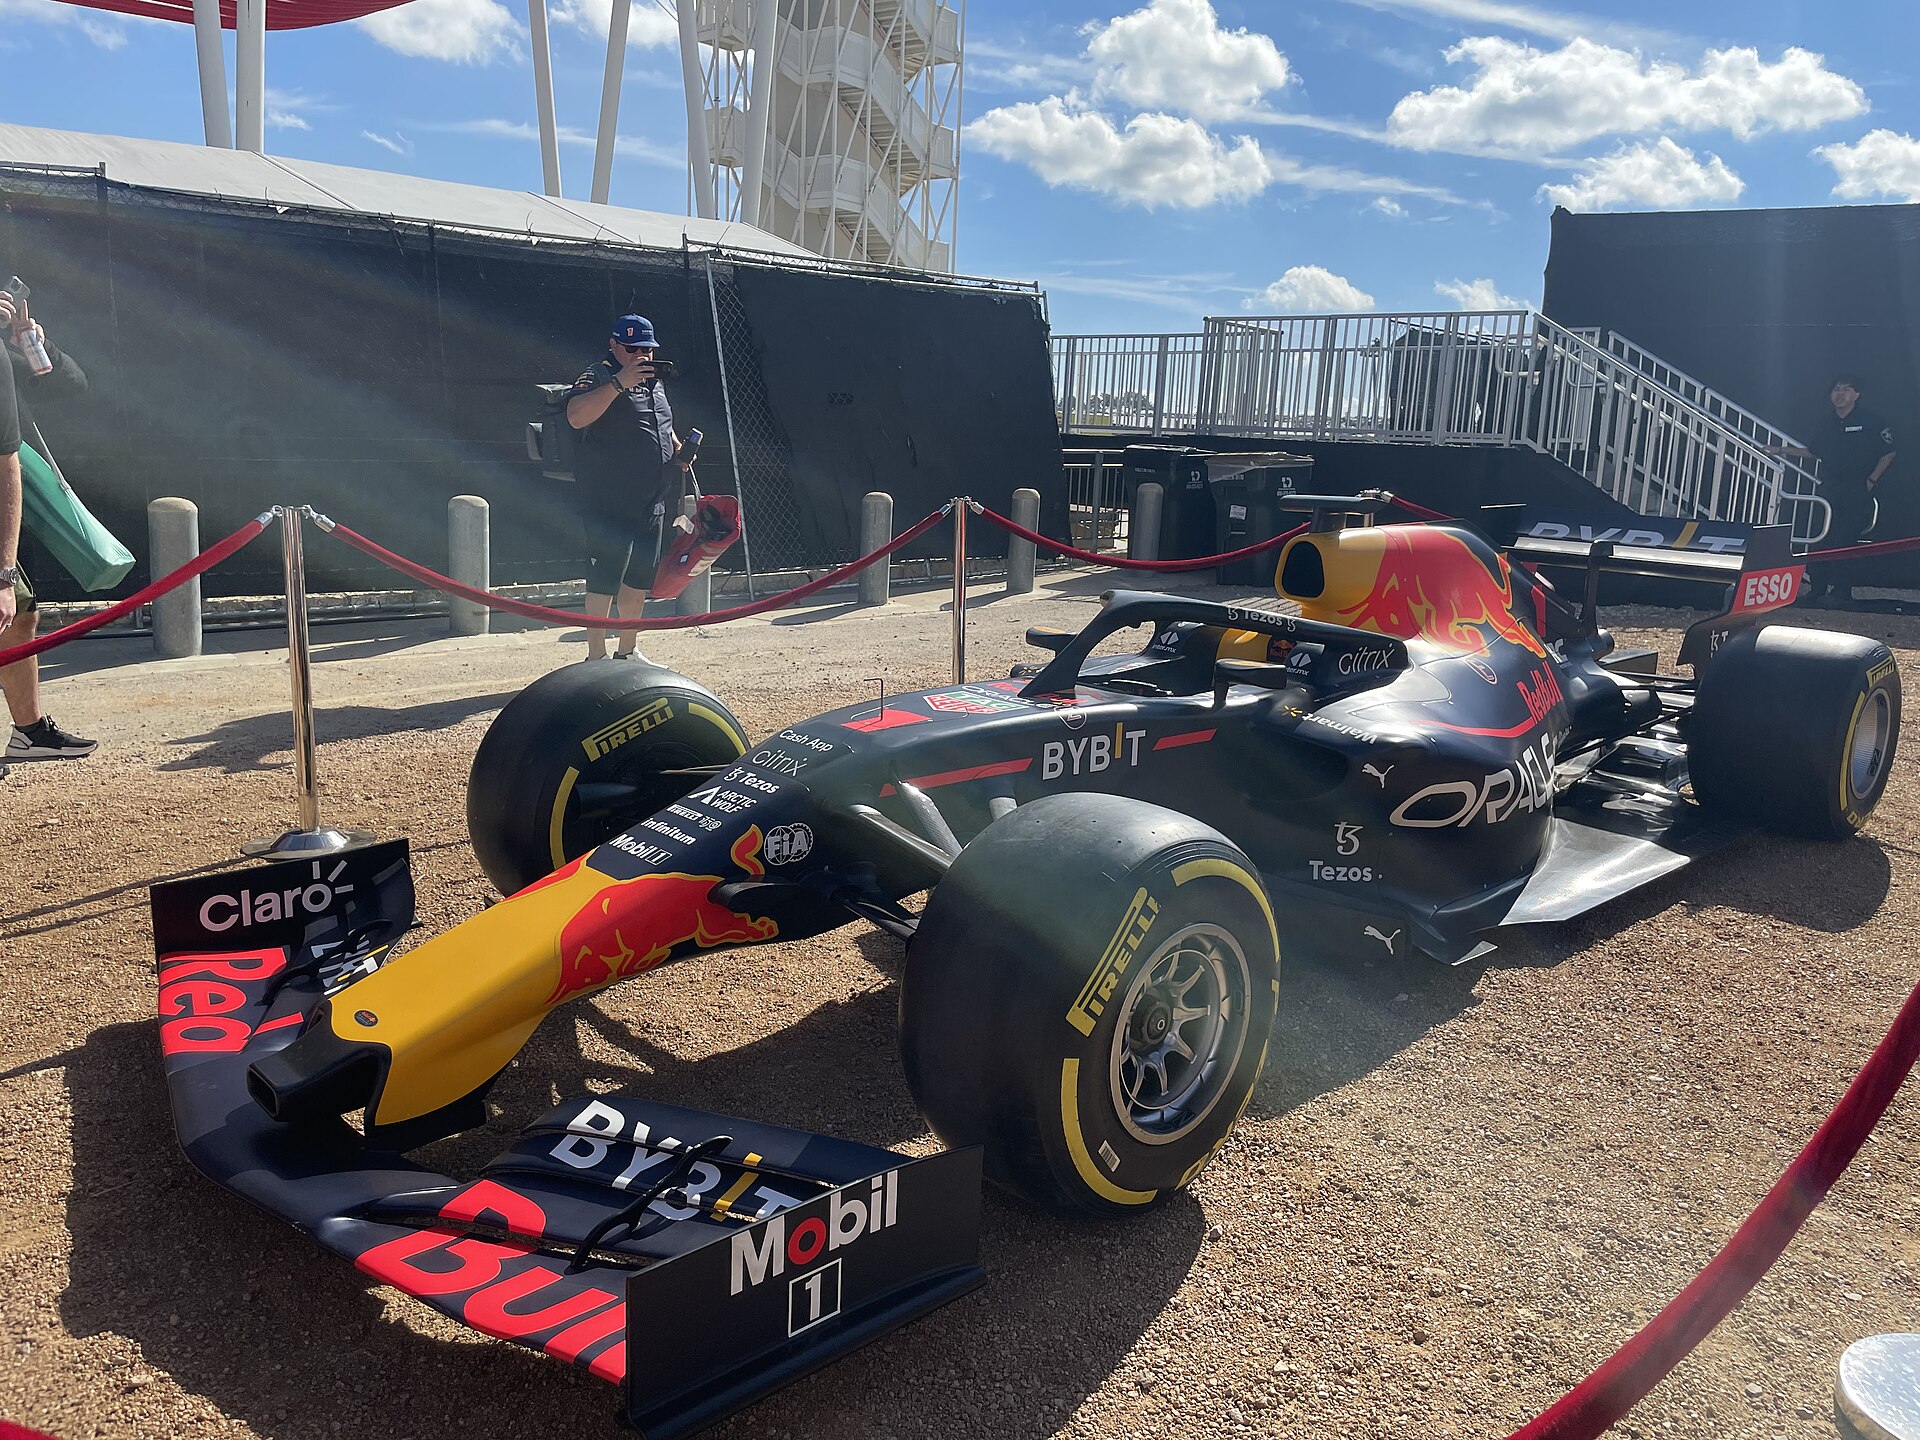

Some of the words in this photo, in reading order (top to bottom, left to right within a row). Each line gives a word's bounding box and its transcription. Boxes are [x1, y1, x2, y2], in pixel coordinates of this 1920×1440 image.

[1744, 572, 1792, 606] ESSO
[1243, 608, 1282, 627] Tezos
[1338, 642, 1395, 675] citrix
[1865, 655, 1895, 689] PIRELLI
[581, 697, 674, 762] PIRELLI
[779, 729, 810, 746] Cash
[808, 738, 834, 752] App
[1302, 712, 1377, 744] Walmart
[752, 749, 807, 777] citrix
[1043, 722, 1146, 780] BYBIT
[738, 772, 780, 794] Tezos
[666, 803, 703, 821] PIRELLI
[709, 798, 743, 814] WOLF
[716, 789, 757, 808] ARCTIC
[641, 817, 697, 845] infinitum
[609, 833, 657, 862] Mobil
[1309, 860, 1372, 881] Tezos
[200, 884, 332, 931] Claro
[1066, 887, 1161, 1037] PIRELLI
[158, 946, 304, 1056] Red
[730, 1169, 899, 1296] Mobil
